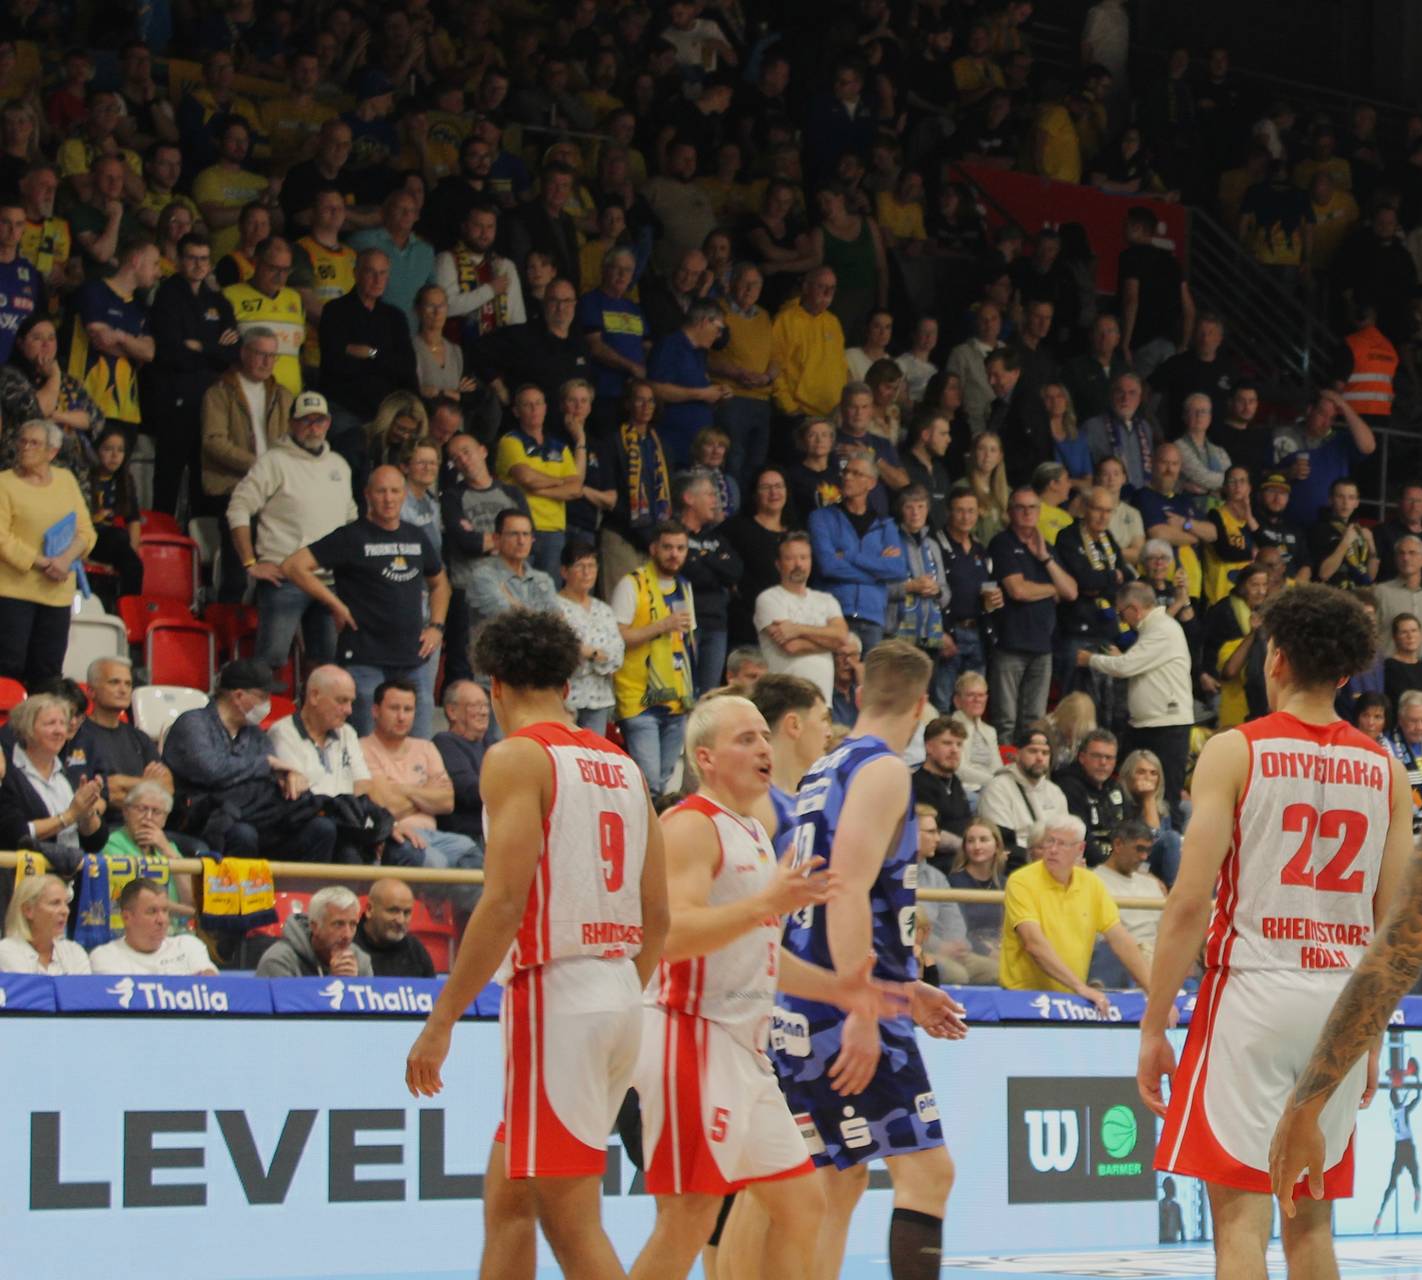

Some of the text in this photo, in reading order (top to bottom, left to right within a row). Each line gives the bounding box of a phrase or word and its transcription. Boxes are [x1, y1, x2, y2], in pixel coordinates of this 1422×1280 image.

[599, 810, 625, 893] 9
[1280, 803, 1369, 893] 22
[1301, 942, 1352, 969] KÖLN
[138, 982, 229, 1012] Thalia
[348, 983, 433, 1013] Thalia
[710, 1106, 732, 1143] 5
[29, 1108, 485, 1211] LEVEL
[1097, 1162, 1143, 1177] BARMER
